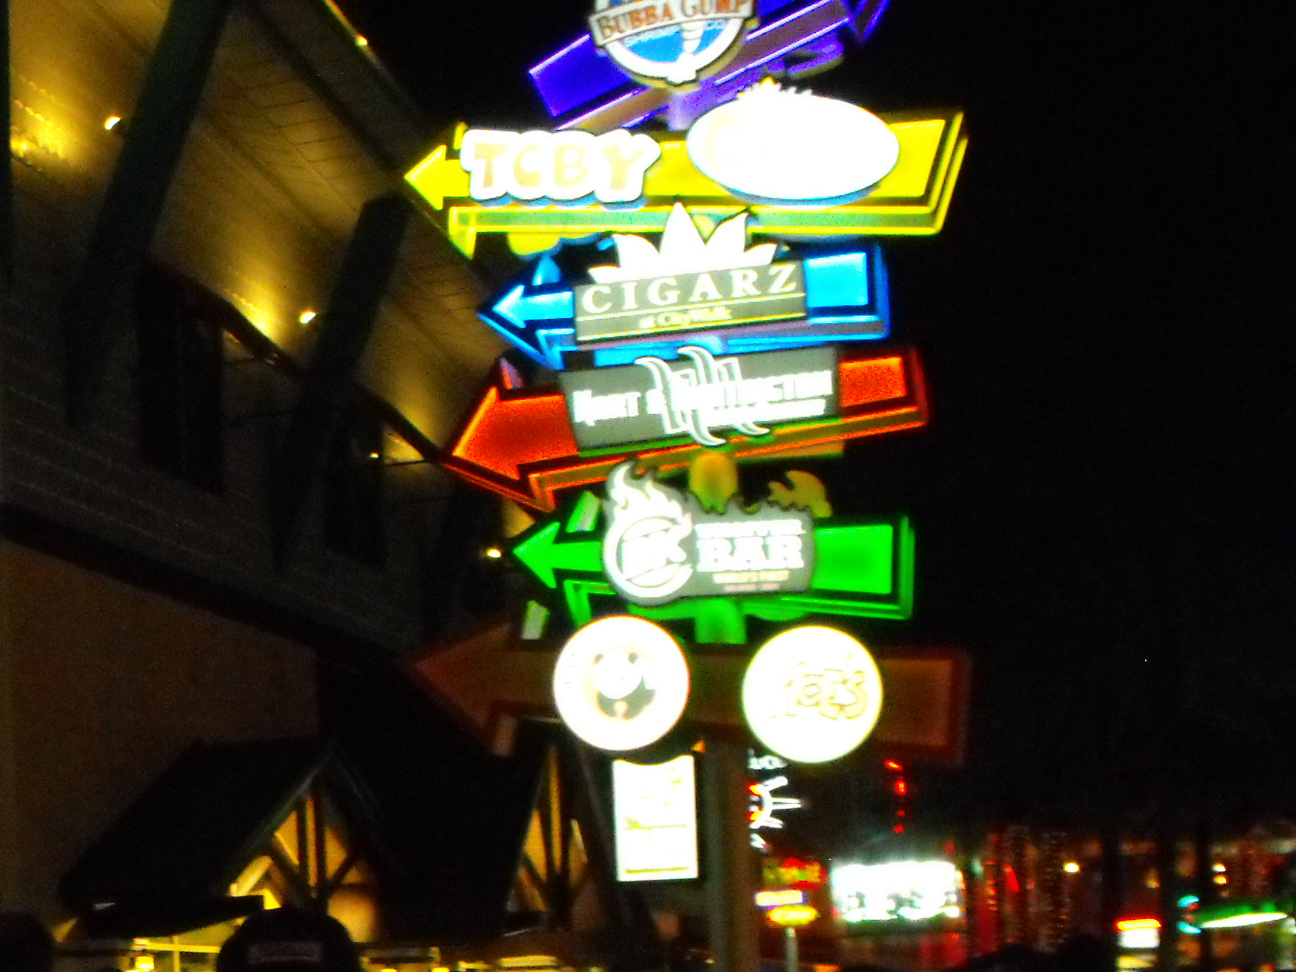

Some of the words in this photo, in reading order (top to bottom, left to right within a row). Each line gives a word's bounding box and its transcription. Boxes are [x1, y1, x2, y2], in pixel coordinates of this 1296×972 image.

[596, 3, 674, 39] BUBBA
[470, 138, 648, 193] TCBY
[581, 263, 797, 313] CIGARZ
[696, 535, 805, 572] BAR
